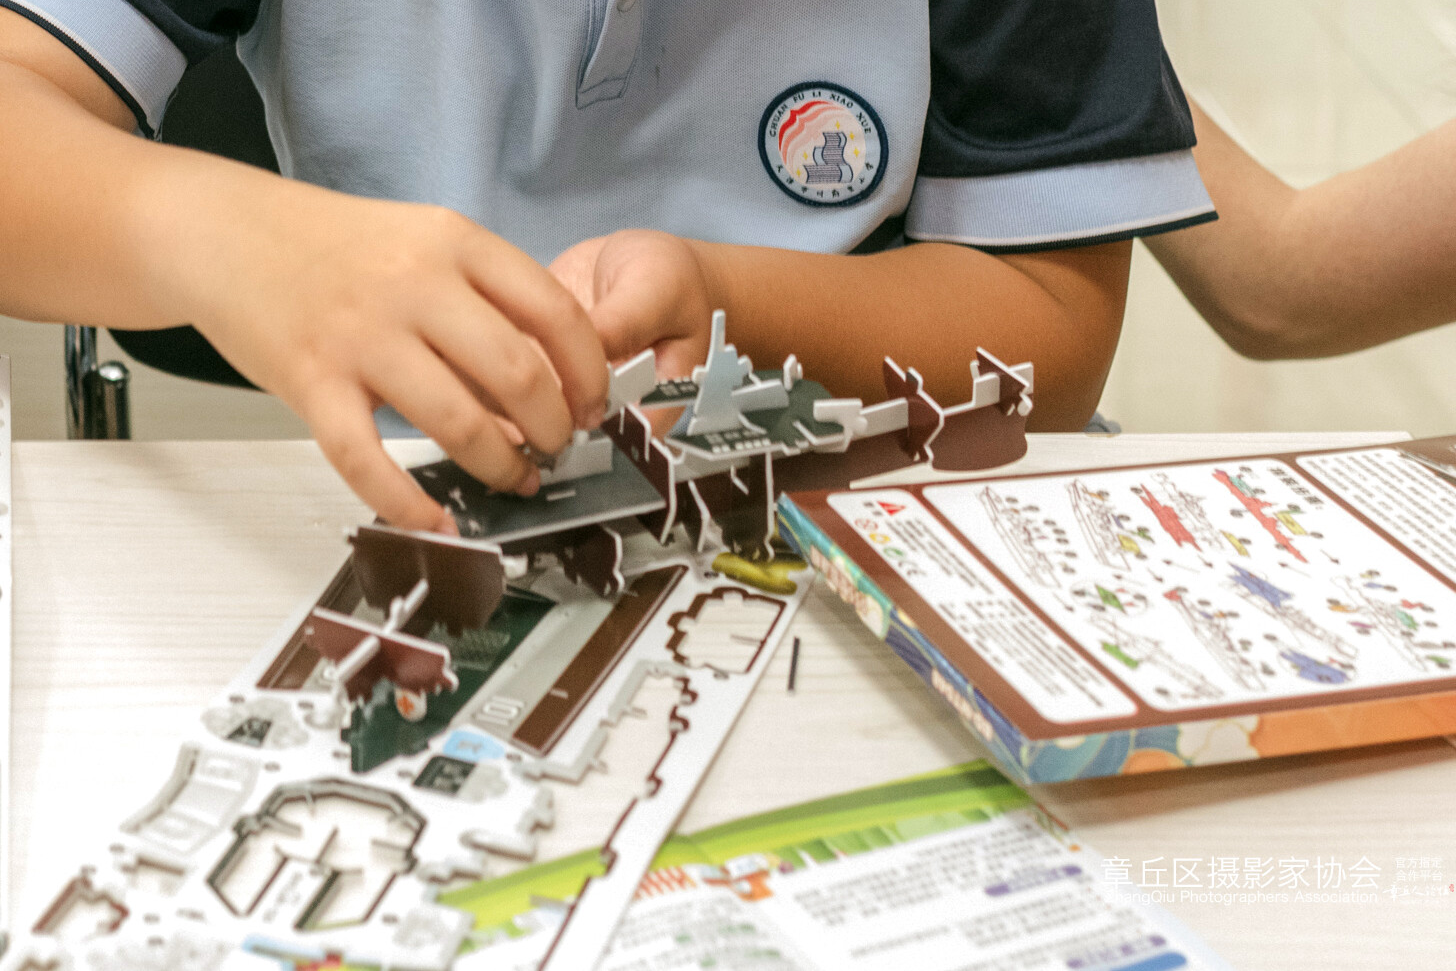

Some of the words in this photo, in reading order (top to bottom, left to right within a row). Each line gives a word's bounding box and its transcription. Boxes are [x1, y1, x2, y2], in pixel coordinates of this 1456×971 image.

[769, 105, 788, 137] CHUAN
[792, 93, 805, 103] FU
[829, 92, 854, 109] XIAO
[855, 111, 872, 135] XUE
